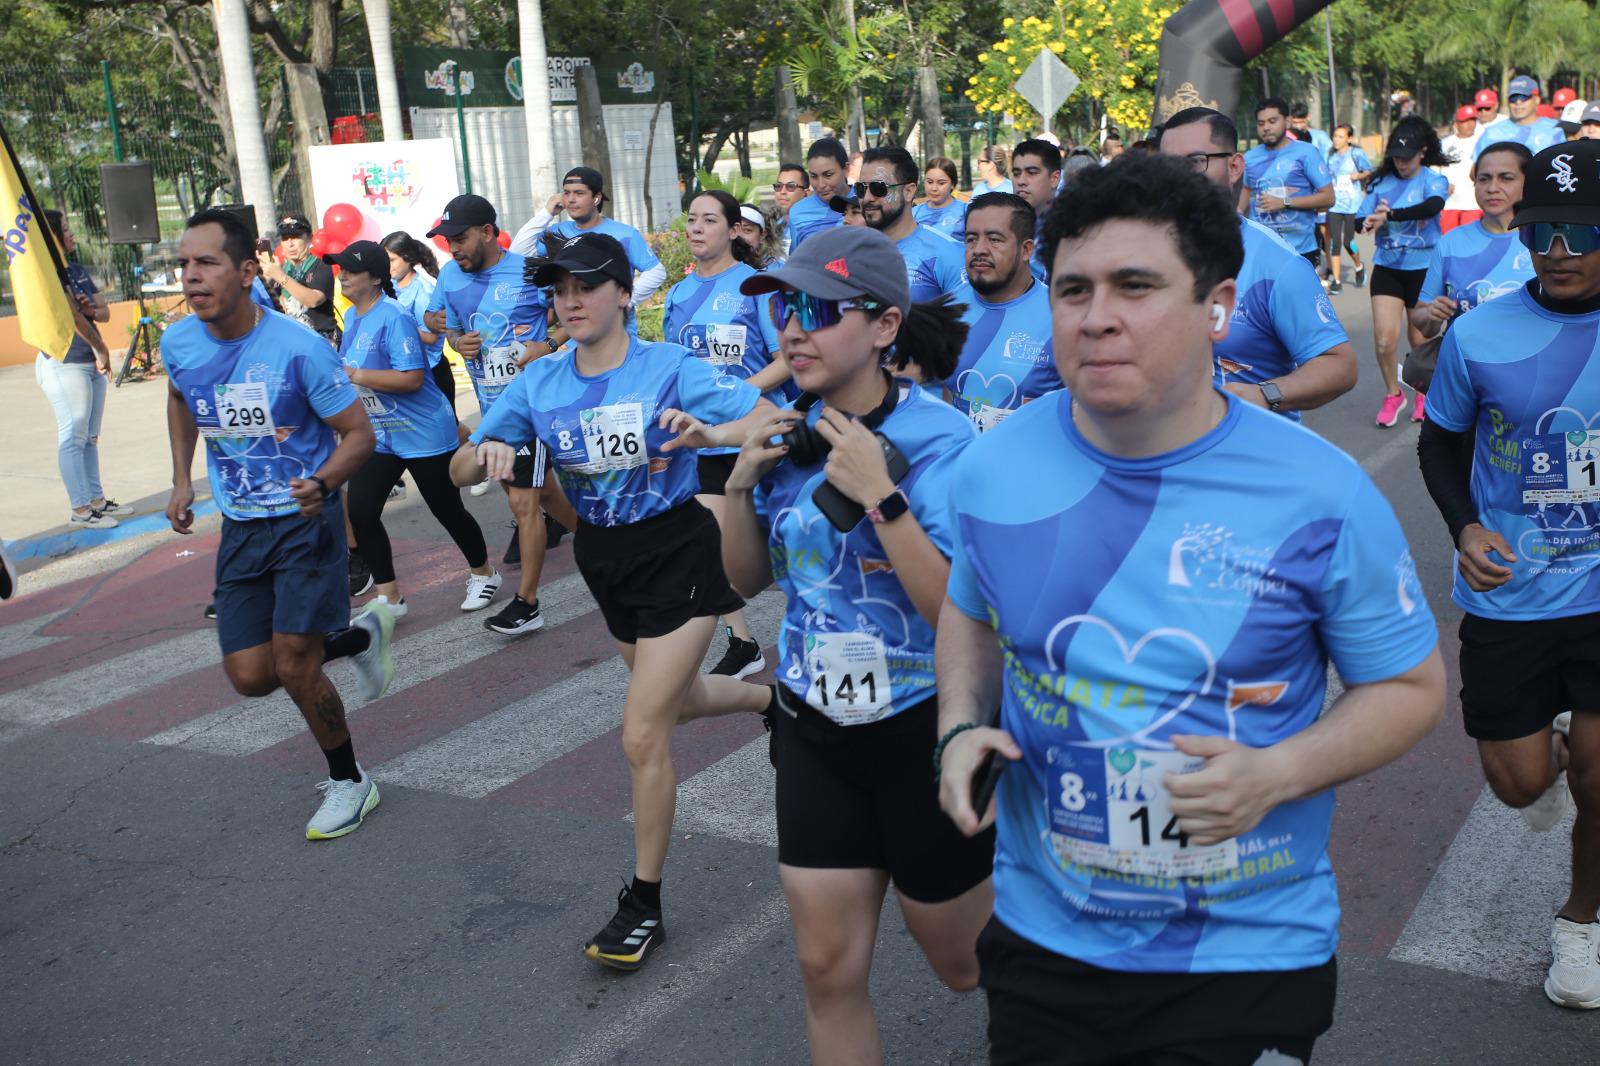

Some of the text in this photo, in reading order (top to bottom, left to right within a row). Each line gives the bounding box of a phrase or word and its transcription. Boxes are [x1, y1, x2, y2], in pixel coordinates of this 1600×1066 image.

[547, 58, 590, 74] ARQUE
[713, 344, 741, 358] 079
[488, 362, 516, 378] 116
[226, 407, 266, 427] 299
[596, 432, 639, 459] 126
[814, 672, 877, 706] 141
